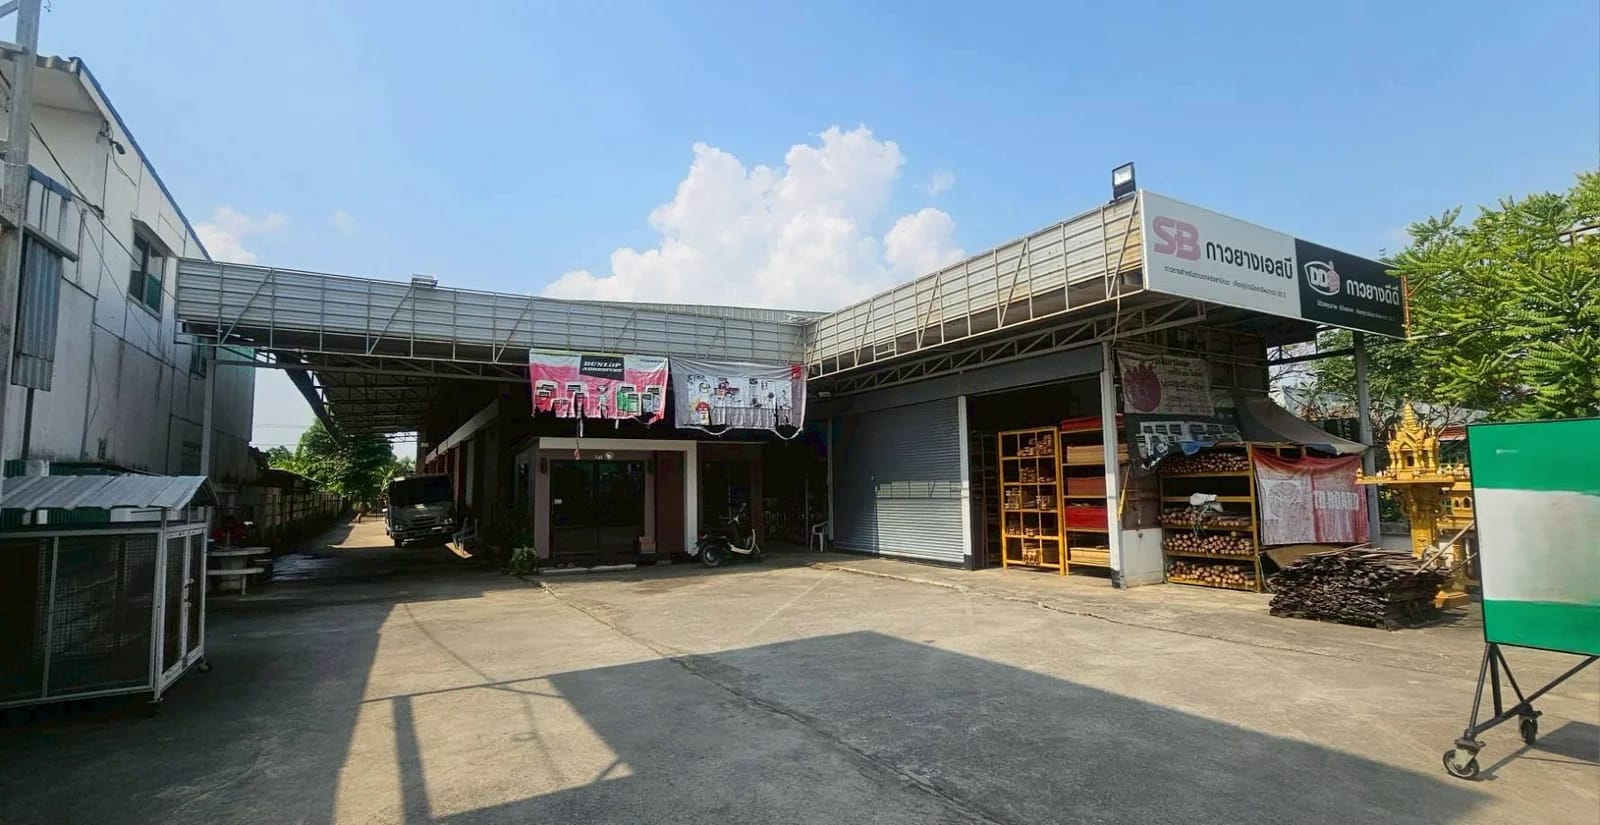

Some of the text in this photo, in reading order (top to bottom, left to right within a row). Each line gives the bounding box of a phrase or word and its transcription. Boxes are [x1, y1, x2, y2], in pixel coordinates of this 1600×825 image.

[1152, 215, 1202, 262] SB
[1206, 241, 1293, 280] กาวยางเอสบี
[1309, 266, 1329, 287] DD
[1346, 279, 1400, 305] กาวยางดีดี
[1328, 491, 1359, 510] BOARD
